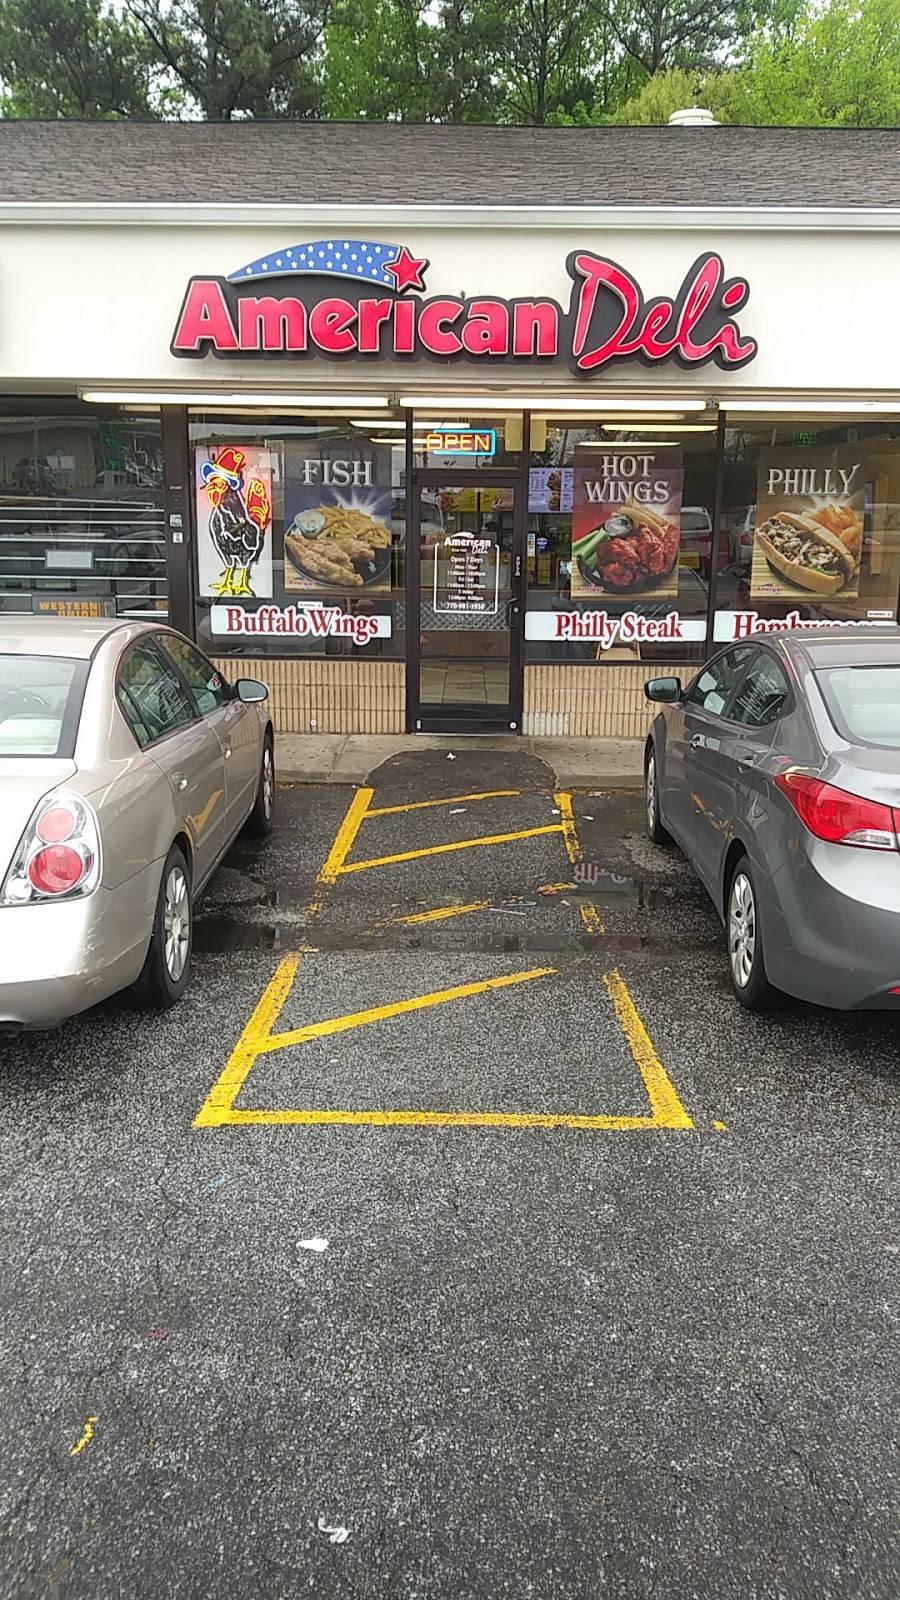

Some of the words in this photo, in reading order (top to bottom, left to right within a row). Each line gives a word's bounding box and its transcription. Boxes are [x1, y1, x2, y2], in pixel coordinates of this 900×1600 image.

[173, 279, 559, 355] American
[571, 253, 755, 369] Deli
[426, 433, 490, 451] OPEN
[302, 459, 374, 488] FISH
[600, 453, 656, 478] HOT
[584, 476, 671, 503] WINGS
[766, 464, 860, 497] PHILLY
[443, 536, 492, 547] American
[471, 544, 488, 554] Deli
[450, 556, 466, 564] Open
[470, 556, 484, 565] Days
[39, 601, 98, 610] WESTERN
[555, 613, 618, 646] Philly
[622, 612, 683, 638] Steak
